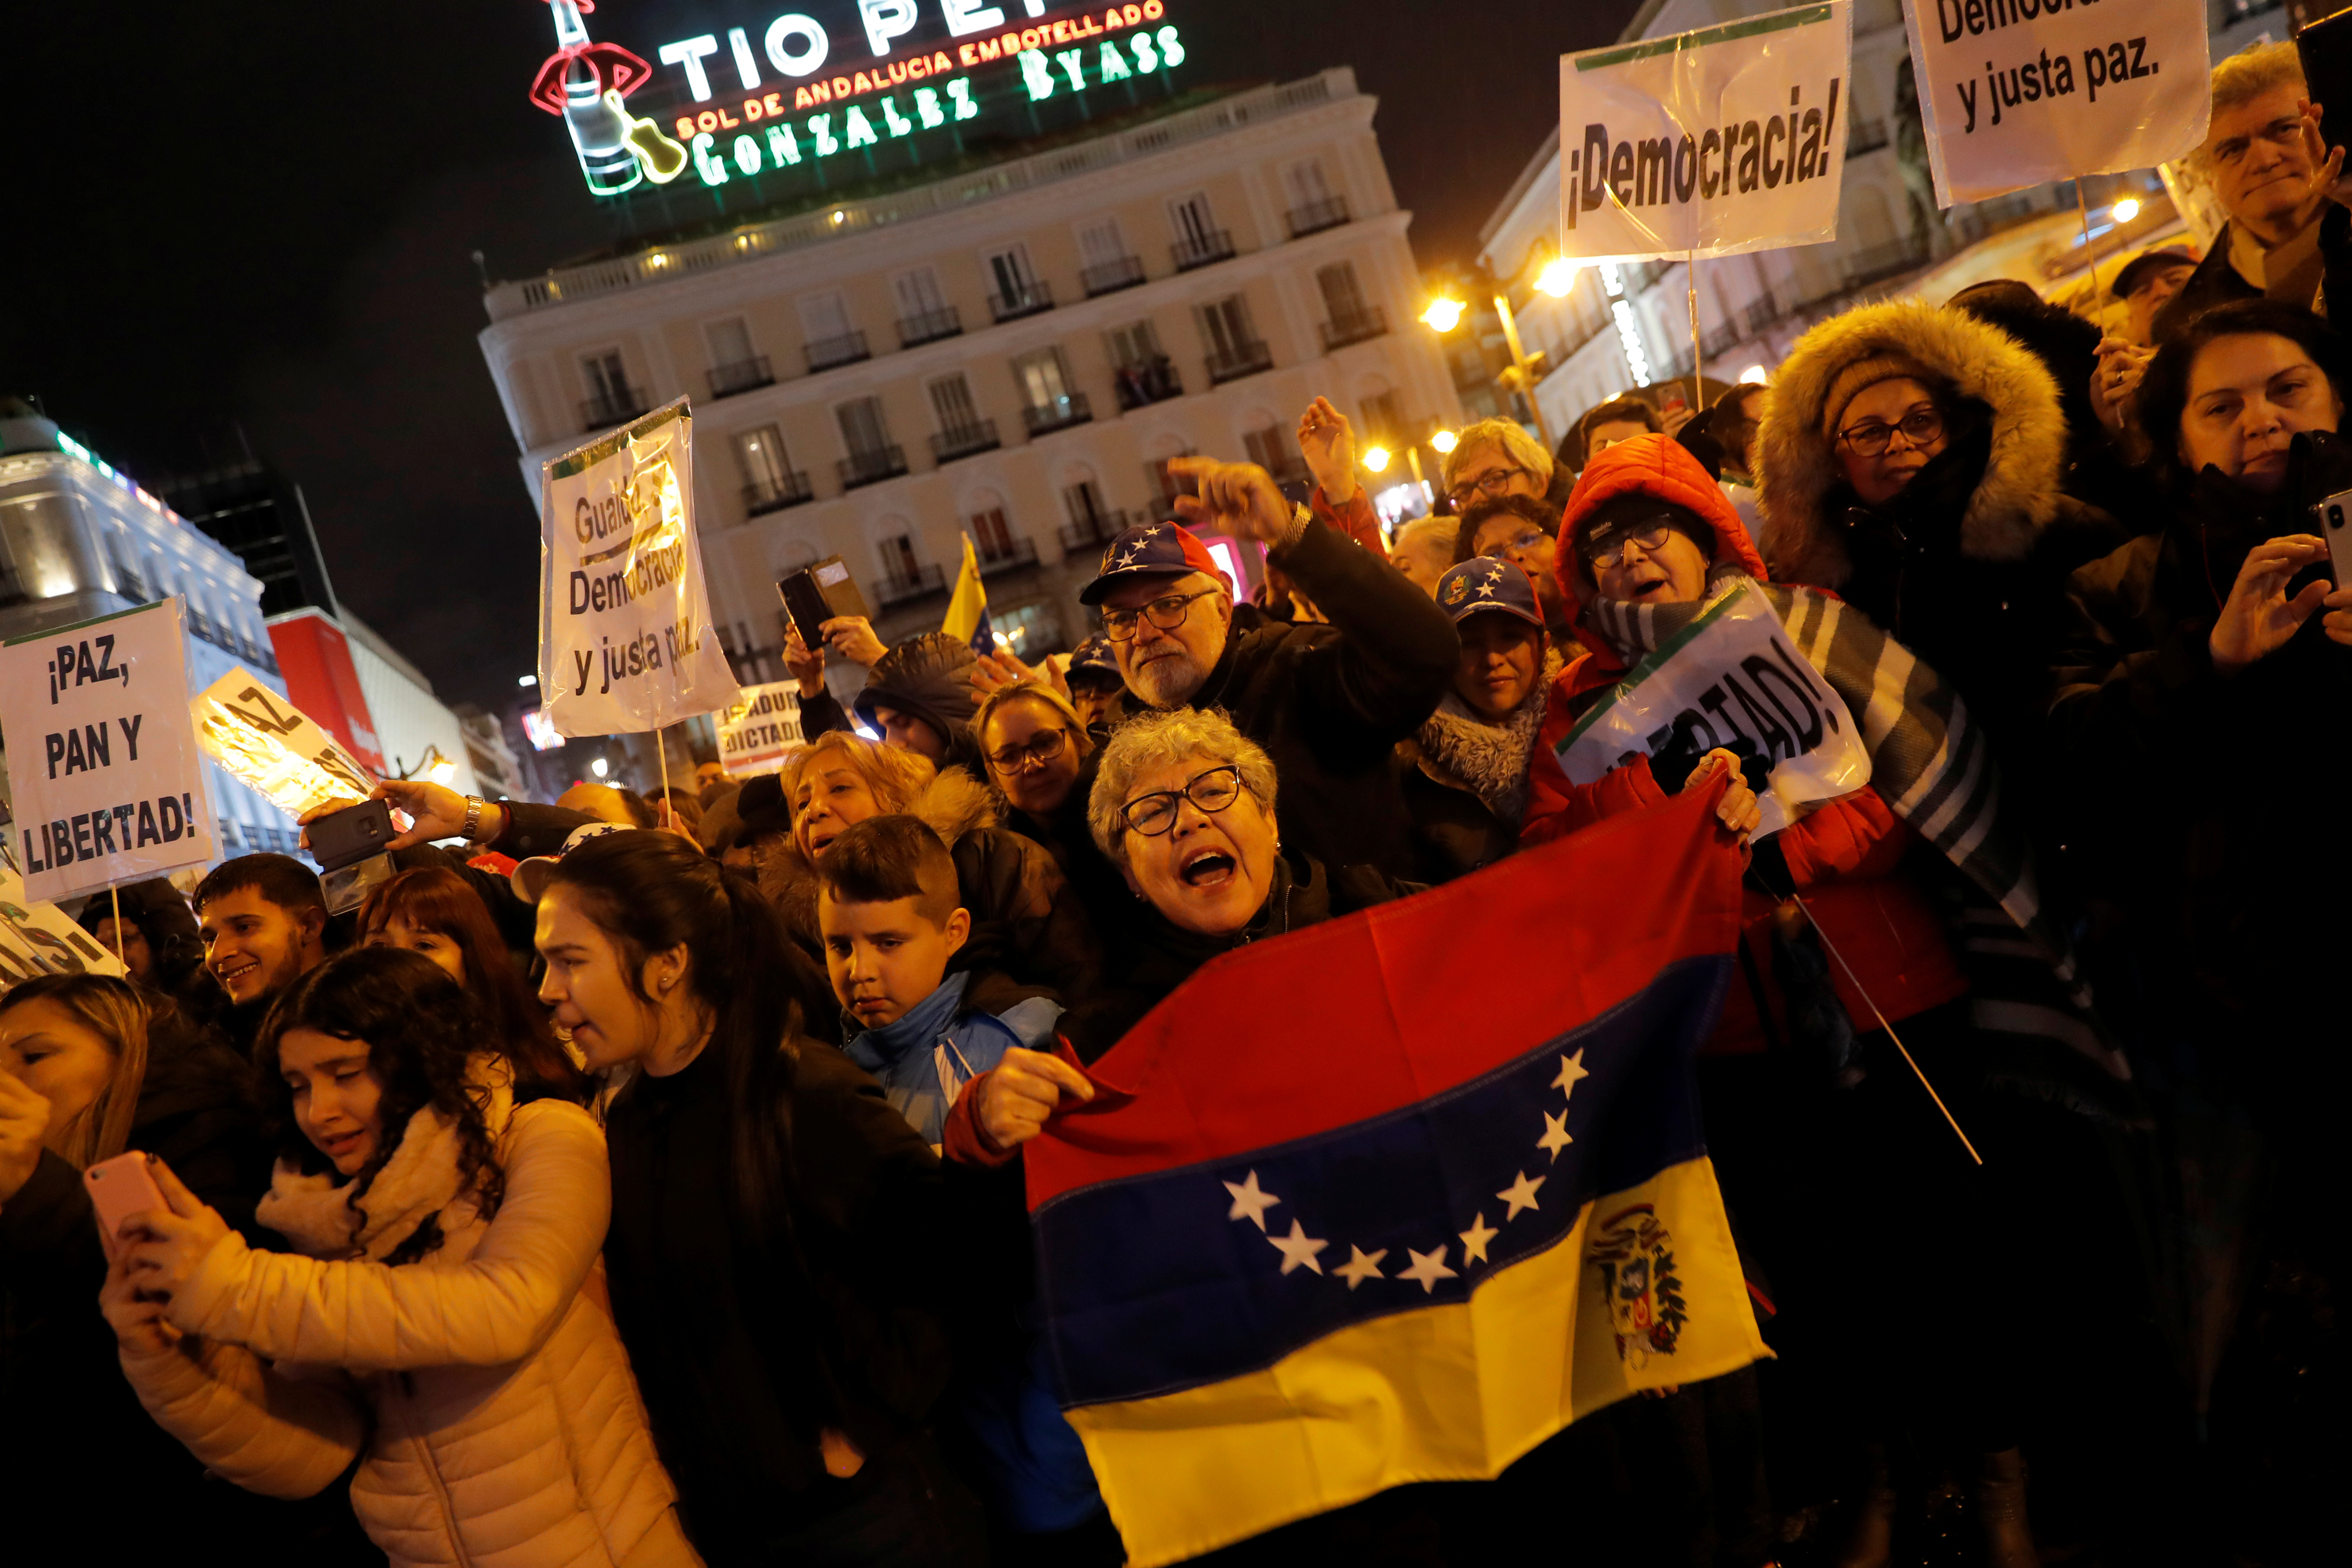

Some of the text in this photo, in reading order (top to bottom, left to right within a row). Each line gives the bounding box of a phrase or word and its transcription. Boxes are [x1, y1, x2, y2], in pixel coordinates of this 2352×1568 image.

[658, 0, 1046, 102] TIO PE
[676, 0, 1164, 140] SOL DE ANDALUCIA EMBOTELLADO
[1957, 36, 2159, 133] y justa paz.
[692, 25, 1185, 186] GONZALEZ BYASS
[1568, 77, 1839, 230] ¡Democracia!
[48, 634, 129, 705] ¡PAZ,
[574, 616, 700, 696] y justa paz.
[45, 714, 142, 779] PAN Y
[24, 793, 196, 875] LIBERTAD!
